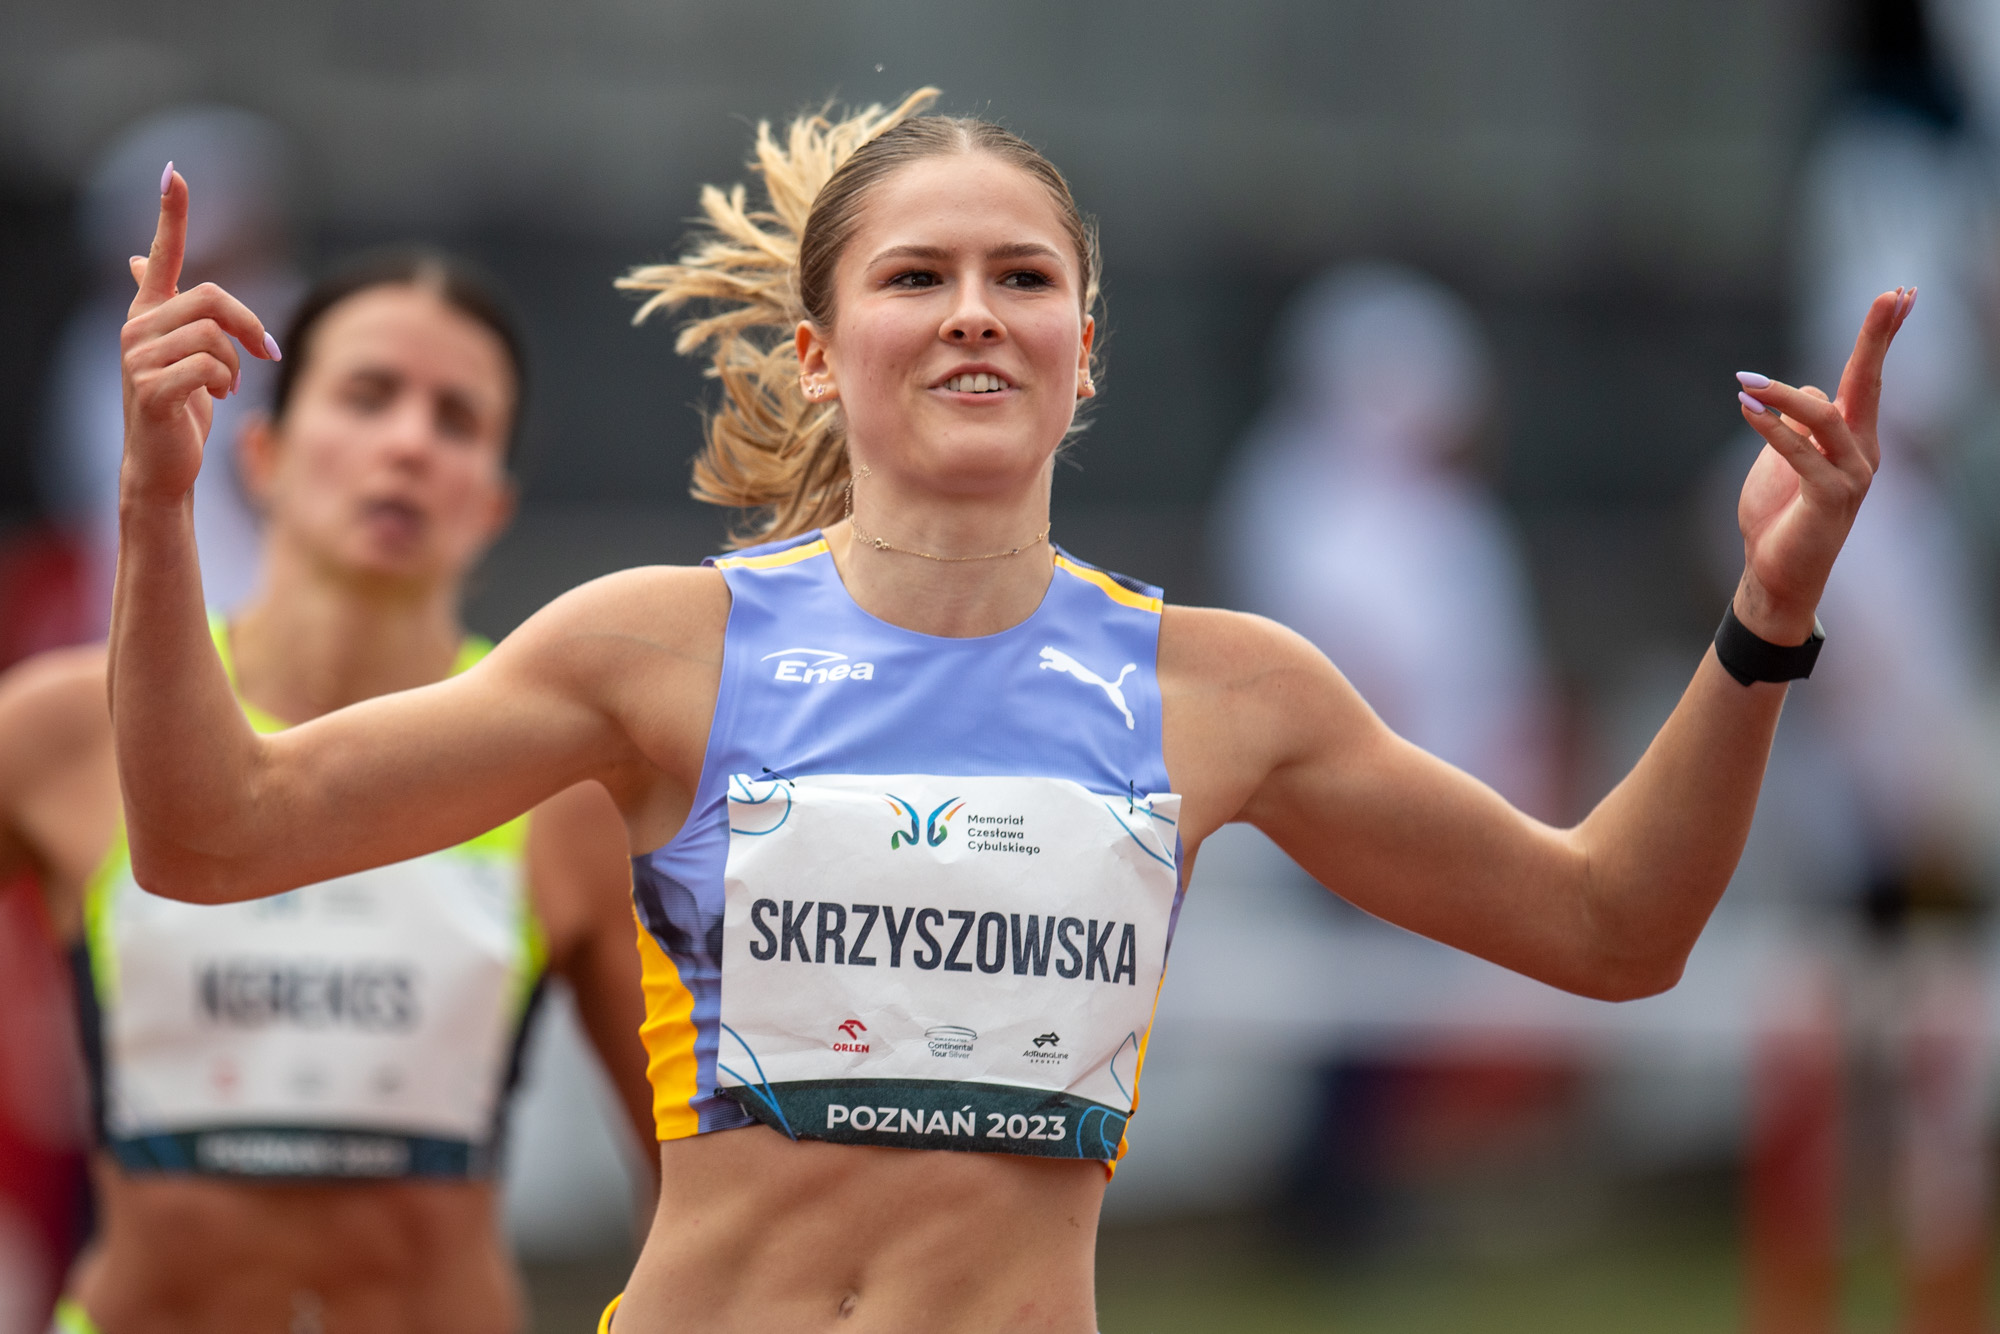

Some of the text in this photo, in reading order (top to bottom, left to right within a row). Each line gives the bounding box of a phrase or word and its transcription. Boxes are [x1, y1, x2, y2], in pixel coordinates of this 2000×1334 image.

[775, 660, 875, 684] Enea
[967, 815, 1024, 826] Memoriał
[967, 827, 1025, 840] Czesława
[967, 840, 1041, 856] Cybulskiego
[749, 897, 1137, 987] SKRZYSZOWSKA
[833, 1043, 870, 1054] ORLEN
[928, 1041, 974, 1052] Continental
[930, 1049, 970, 1060] Tour Silver
[826, 1104, 1067, 1141] POZNAŃ 2023
